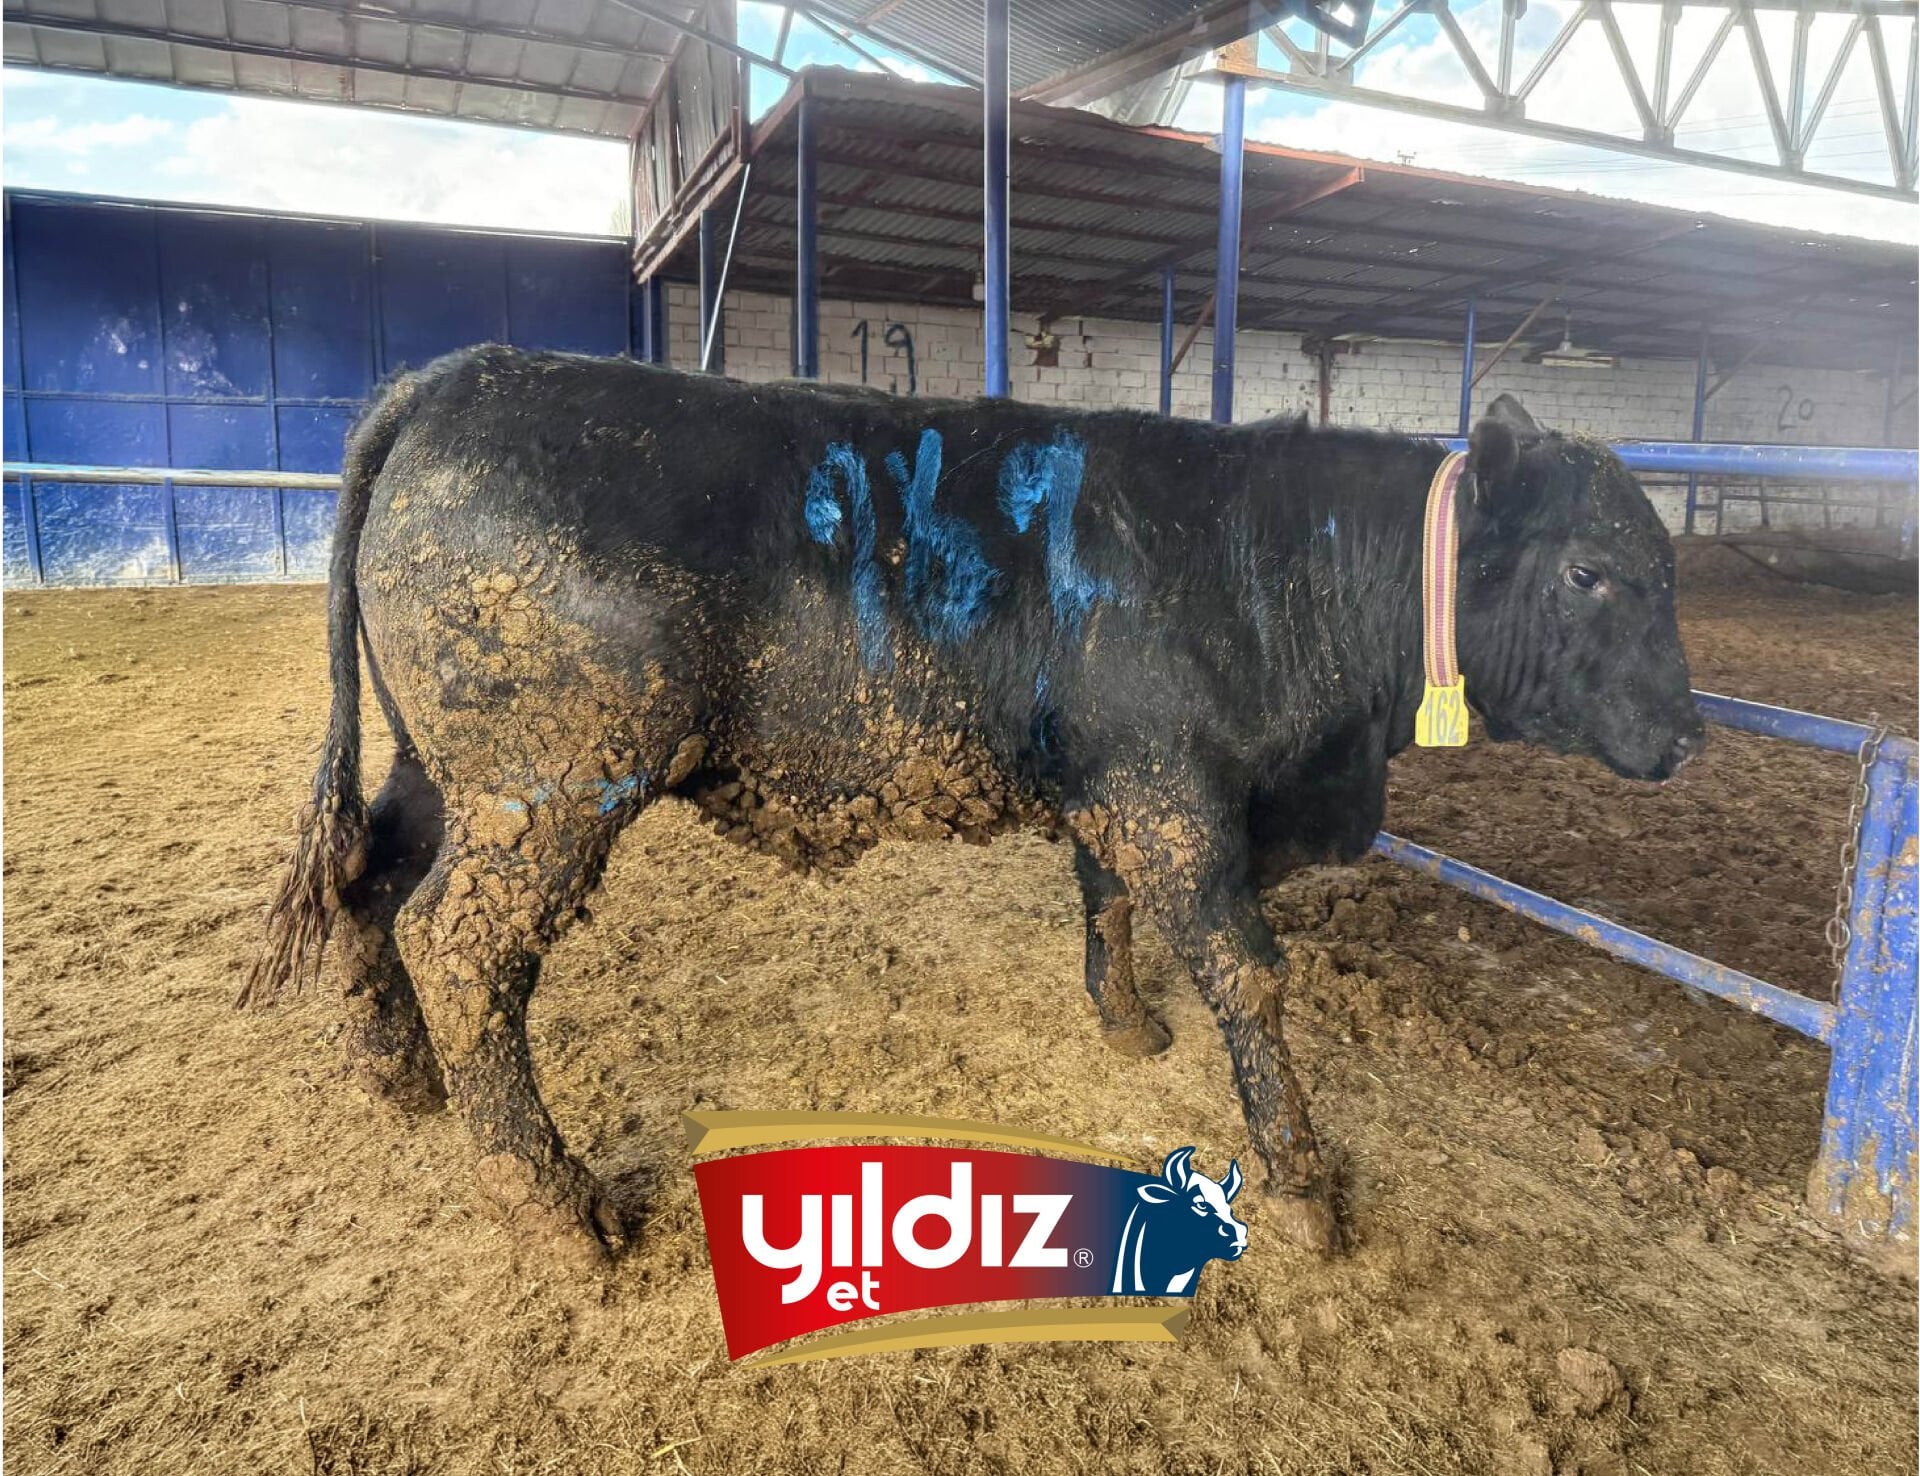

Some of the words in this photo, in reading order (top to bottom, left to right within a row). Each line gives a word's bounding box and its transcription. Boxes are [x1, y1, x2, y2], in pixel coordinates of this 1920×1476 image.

[850, 319, 917, 395] 19
[1777, 384, 1816, 434] 20
[1425, 689, 1461, 745] 162
